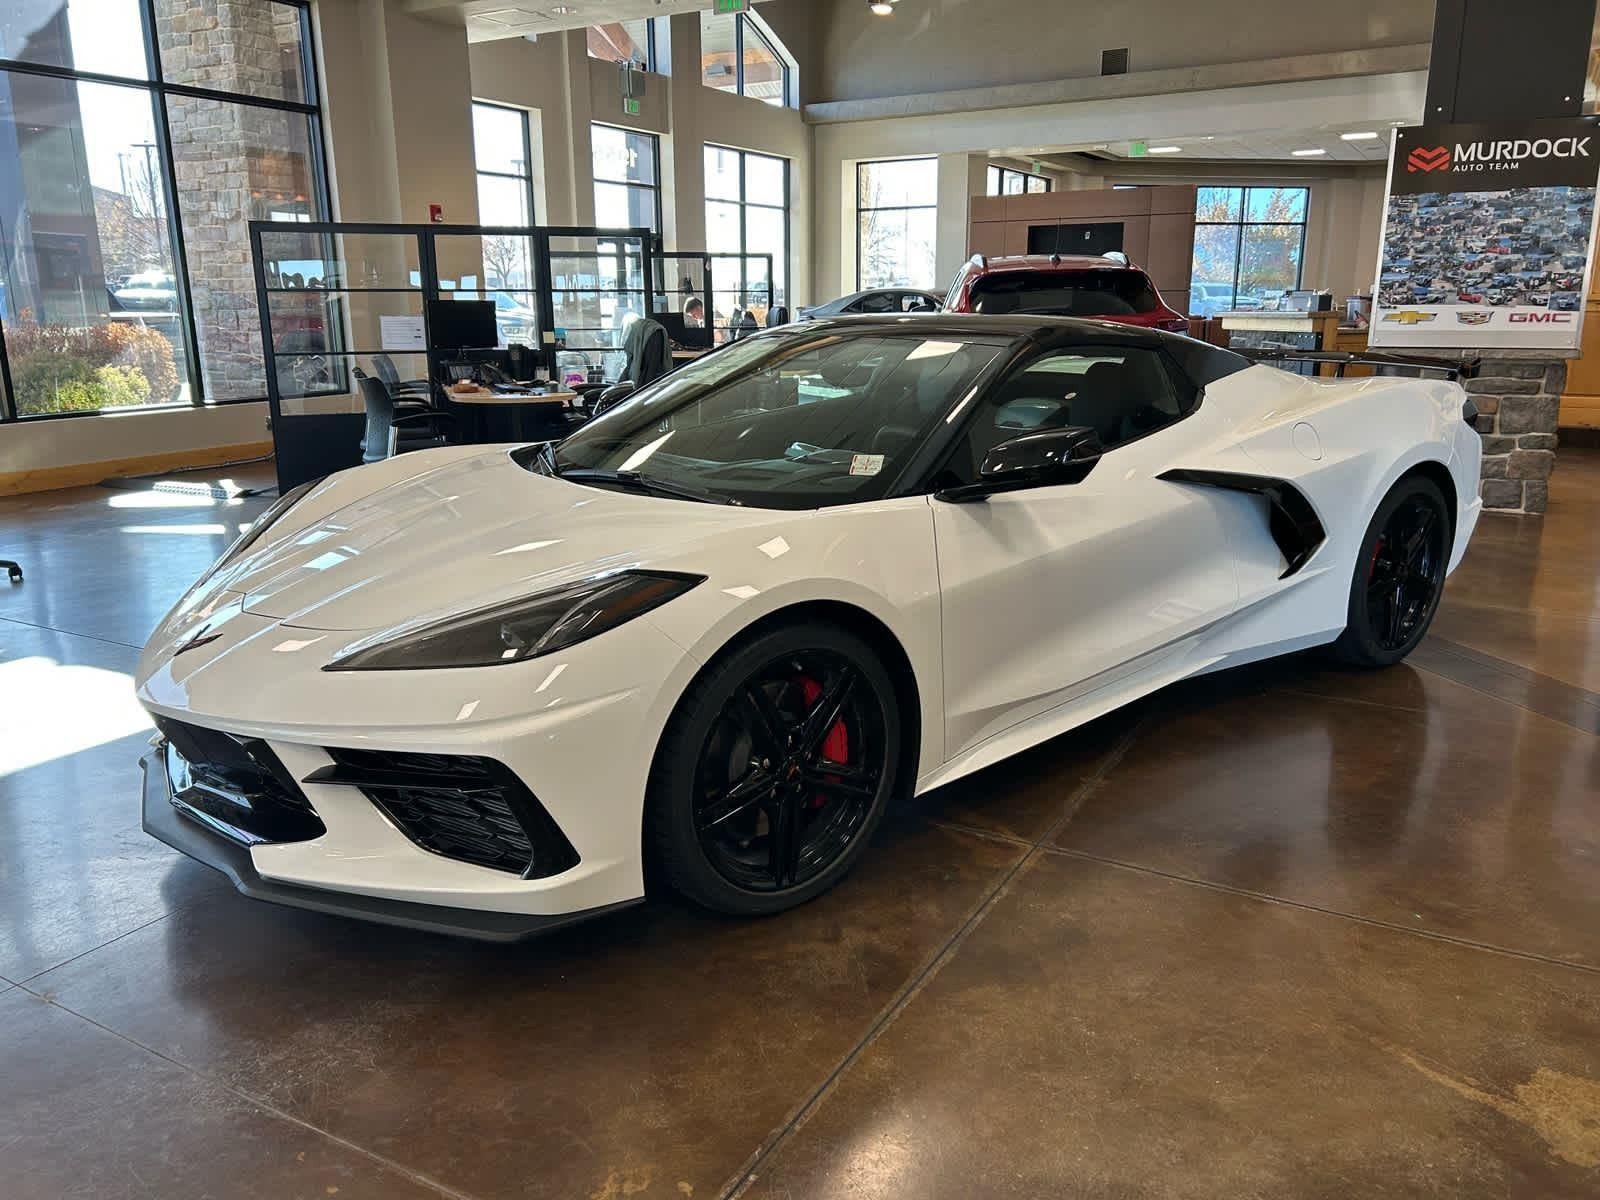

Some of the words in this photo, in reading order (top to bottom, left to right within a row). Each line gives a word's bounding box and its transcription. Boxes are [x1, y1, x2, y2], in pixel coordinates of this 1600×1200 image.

[1453, 137, 1591, 162] MURDOCK
[1452, 163, 1484, 172] AUTO
[1488, 162, 1520, 170] TEAM
[1508, 313, 1572, 323] GMC
